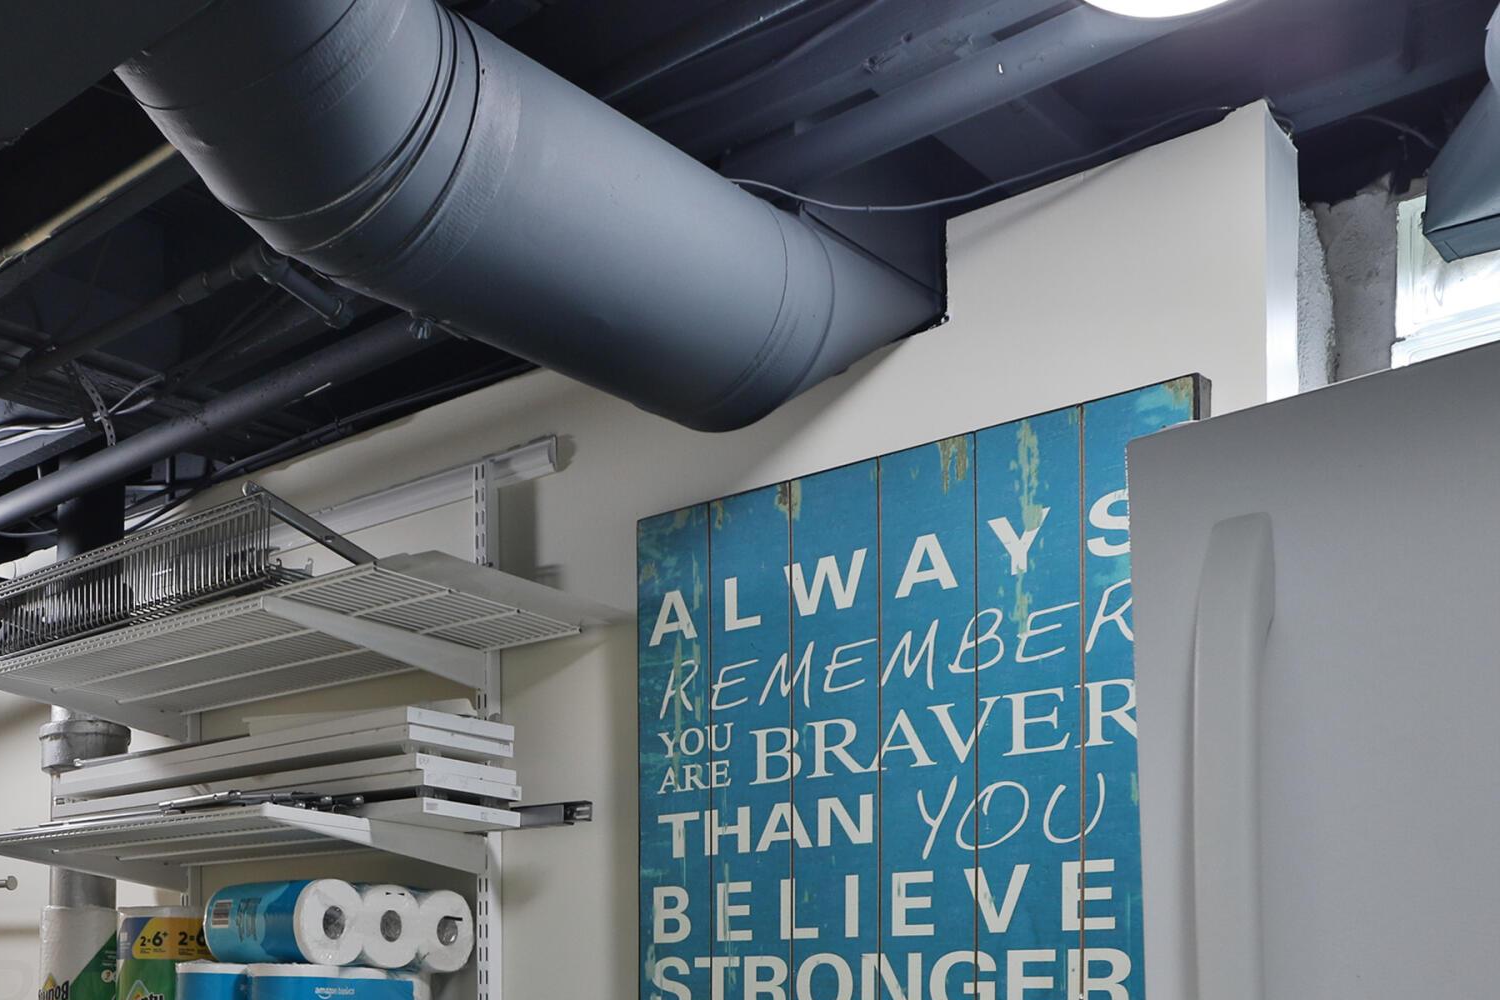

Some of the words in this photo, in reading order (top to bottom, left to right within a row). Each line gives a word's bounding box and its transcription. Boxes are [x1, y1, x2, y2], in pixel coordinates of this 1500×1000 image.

[649, 489, 1131, 647] ALWAYS
[659, 578, 1135, 719] REMEMBER
[657, 723, 733, 758] YOU
[749, 678, 1138, 785] BRAVER
[657, 760, 732, 794] ARE
[658, 794, 874, 859] THAN
[917, 772, 1106, 860] YOU
[653, 859, 1116, 944] BELIEVE
